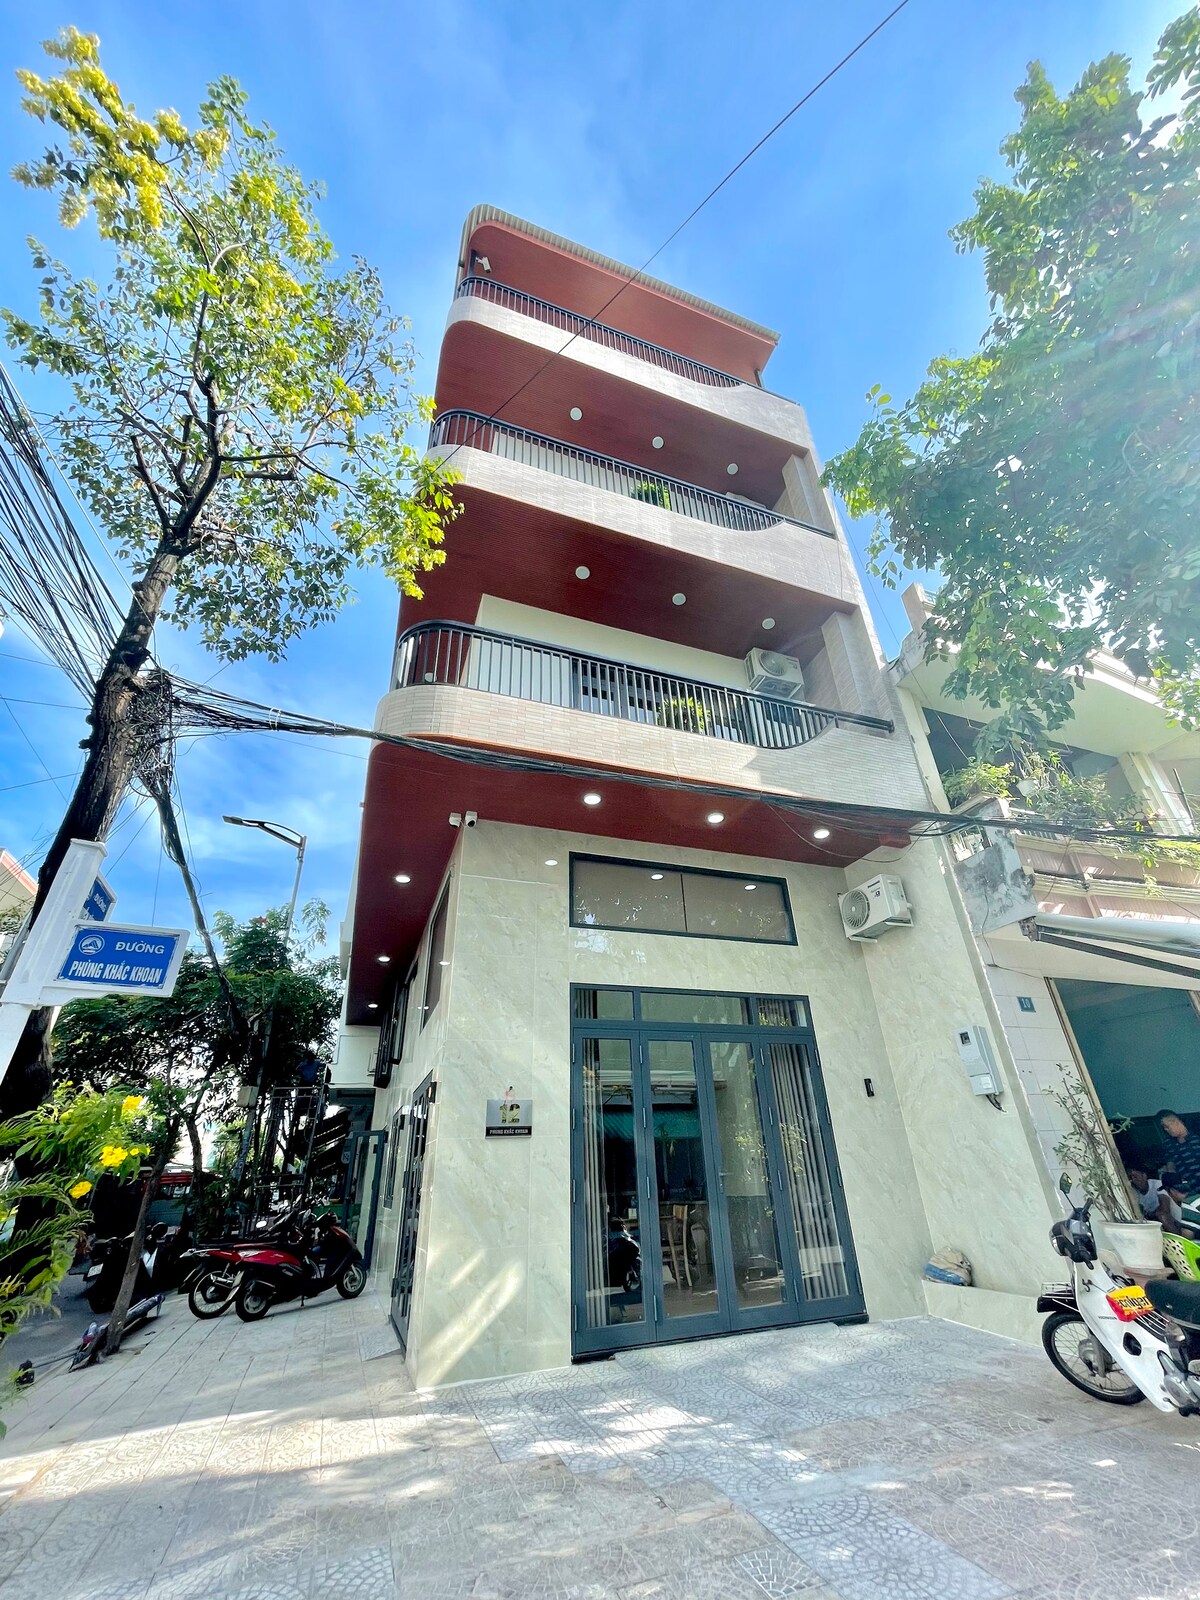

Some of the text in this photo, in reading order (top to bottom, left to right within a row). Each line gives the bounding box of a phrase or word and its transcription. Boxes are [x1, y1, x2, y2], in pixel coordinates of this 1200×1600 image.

[115, 940, 165, 954] ĐƯỜNG
[102, 960, 129, 980] KHẮC
[129, 966, 162, 983] KHOAN
[500, 1104, 520, 1123] 12
